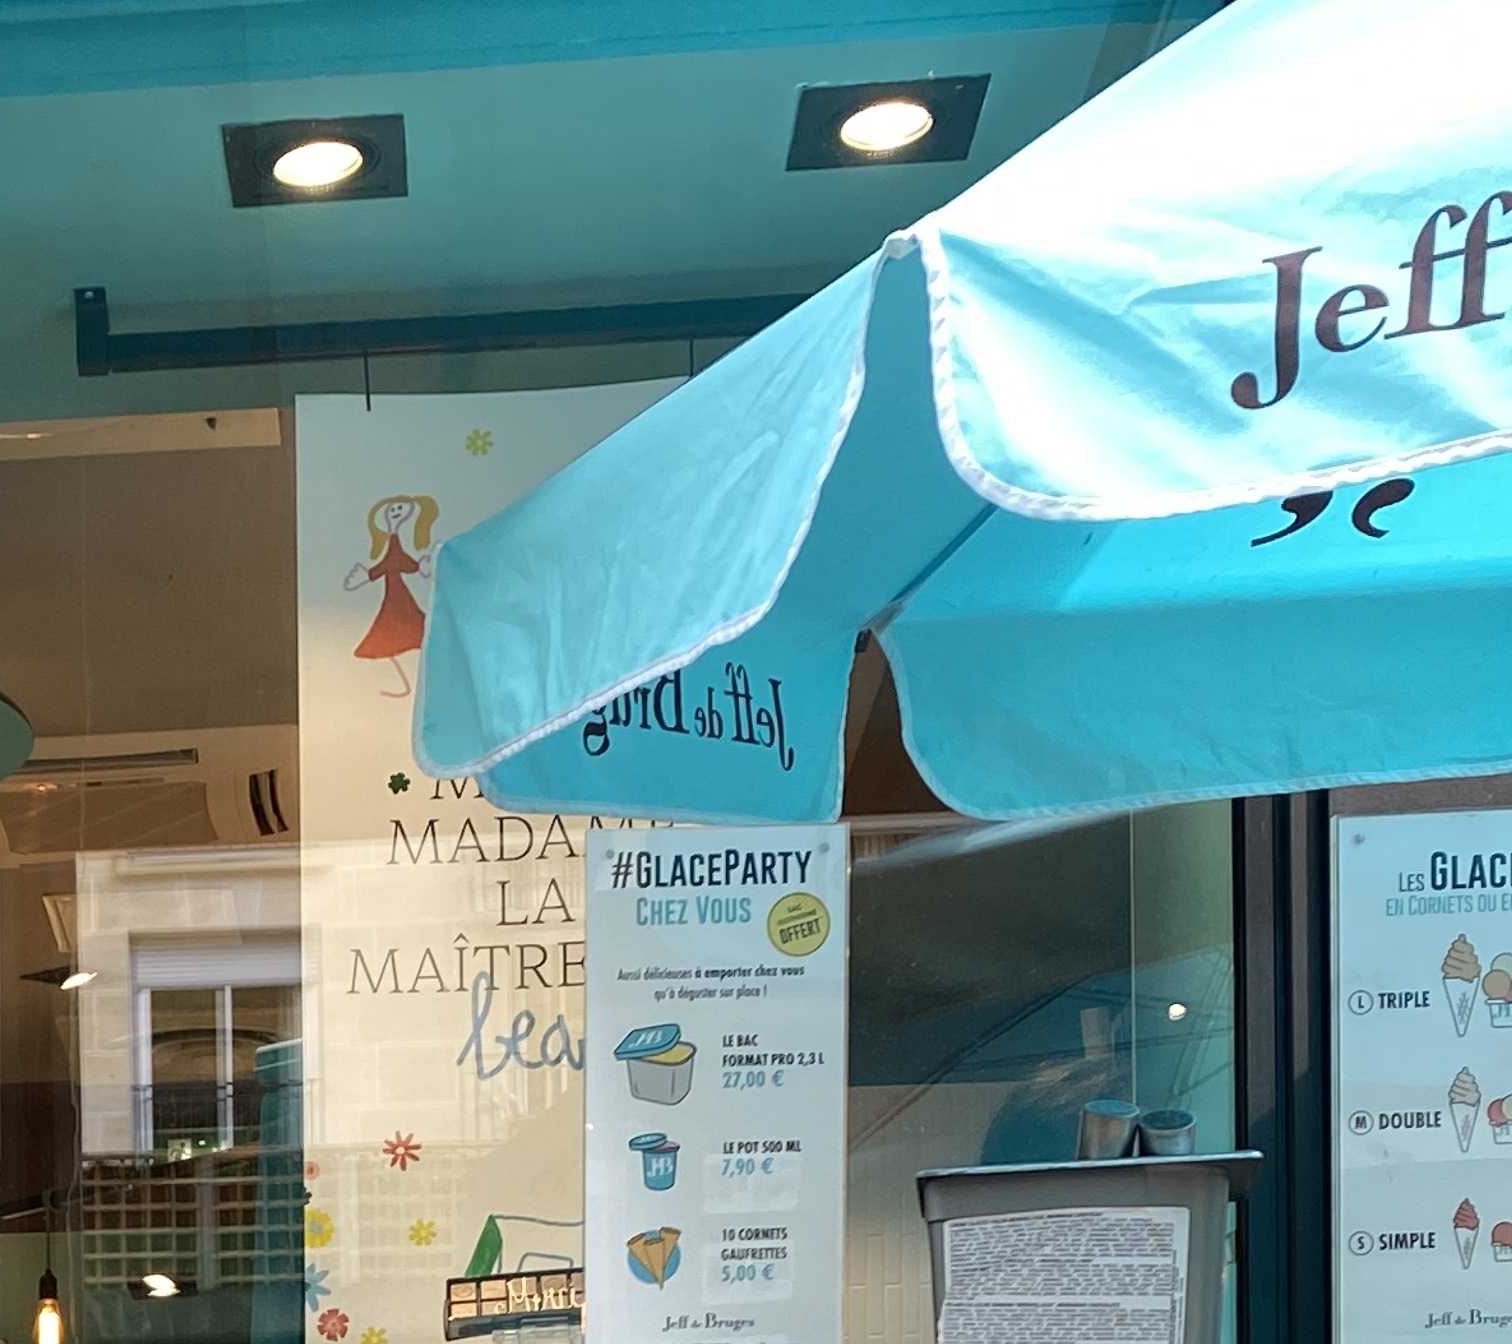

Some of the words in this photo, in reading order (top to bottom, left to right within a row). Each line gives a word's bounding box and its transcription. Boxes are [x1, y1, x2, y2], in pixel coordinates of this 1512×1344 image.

[1231, 190, 1512, 410] Jeff
[611, 848, 812, 890] #GLACEPARTY
[1398, 871, 1425, 892] LES
[1430, 850, 1512, 891] GLAC
[496, 877, 576, 927] LA
[635, 896, 688, 927] CHEZ
[695, 894, 752, 926] VOUS
[1386, 897, 1405, 917] EN
[1408, 895, 1473, 916] CORNETS
[1478, 893, 1497, 913] OU
[778, 918, 822, 945] OFFERT
[346, 932, 585, 995] MAÎTRE
[704, 966, 752, 982] emporter
[754, 962, 778, 977] chez
[780, 966, 805, 977] vous
[1378, 990, 1431, 1010] TRIPLE
[722, 1034, 734, 1048] LE
[736, 1033, 758, 1047] BAC
[722, 1052, 769, 1068] FORMAT
[770, 1052, 795, 1066] PRO
[796, 1051, 816, 1067] 2,3
[817, 1051, 825, 1065] L
[721, 1070, 766, 1091] 27,00
[771, 1069, 785, 1088] €
[1379, 1111, 1442, 1131] DOUBLE
[722, 1141, 734, 1154] LE
[736, 1140, 759, 1154] POT
[761, 1139, 784, 1154] 500
[721, 1157, 756, 1179] 7,90
[760, 1156, 775, 1175] €
[721, 1228, 736, 1242] 10
[738, 1226, 788, 1241] CORNETS
[1378, 1231, 1437, 1252] SIMPLE
[720, 1246, 788, 1261] GAUFRETTES
[721, 1264, 757, 1285] 5,00
[760, 1262, 776, 1281] €
[662, 1314, 689, 1333] Jeff
[1424, 1311, 1453, 1329] Jeff
